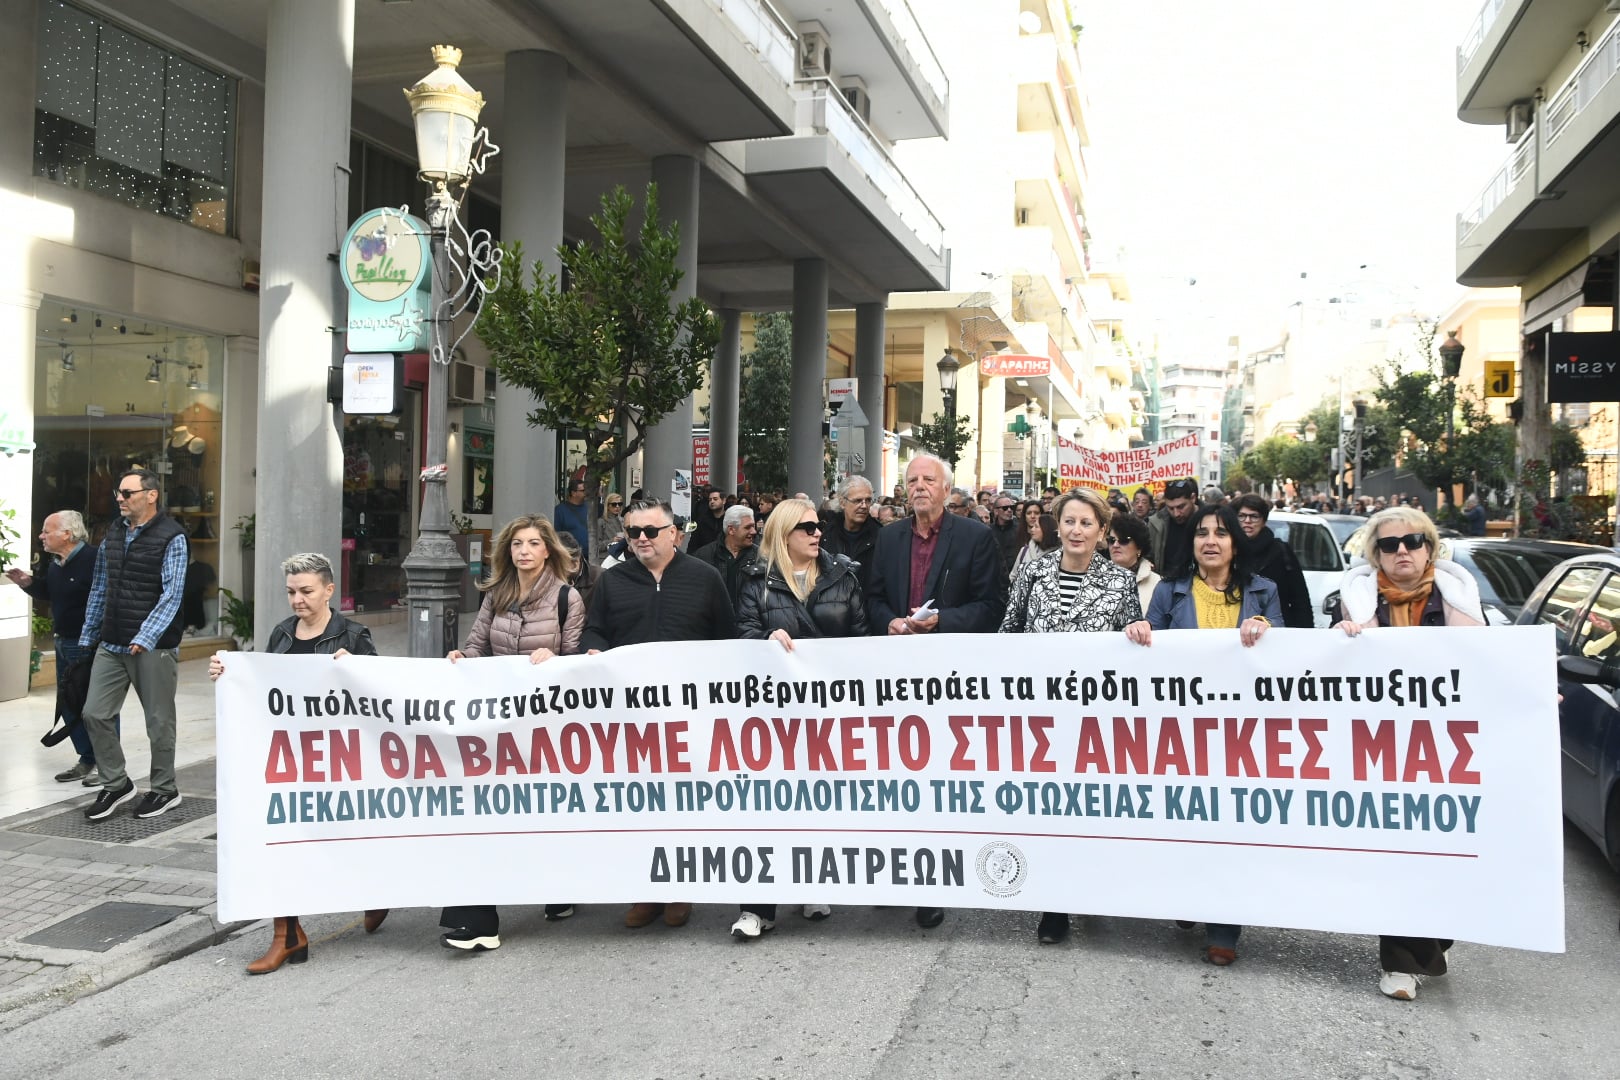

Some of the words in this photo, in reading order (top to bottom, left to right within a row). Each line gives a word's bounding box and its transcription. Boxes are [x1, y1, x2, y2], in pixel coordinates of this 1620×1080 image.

[999, 360, 1049, 370] ΑΡΑΠΗΣ
[695, 454, 709, 466] πά
[1060, 463, 1106, 483] ΕΝΑΝΤΙΑ
[1109, 474, 1136, 487] ΣΤΗΝ
[1138, 462, 1193, 482] ΕΞΑΘΛΙΩΣΗ
[1117, 459, 1154, 474] ΜΕΤΩΠΟ
[268, 687, 295, 717] Οι
[303, 688, 394, 723] πόλεις
[404, 698, 456, 726] μας
[466, 682, 614, 720] στενάζουν
[625, 684, 671, 709] και
[682, 682, 698, 710] η
[708, 674, 865, 708] κυβέρνηση
[875, 670, 990, 706] μετράει
[1001, 676, 1035, 700] τα
[1046, 670, 1138, 707] κέρδη
[1150, 676, 1241, 707] της...
[1254, 669, 1461, 708] ανάπτυξης!
[265, 728, 362, 784] ΔΕΝ
[379, 731, 447, 780] ΘΑ
[456, 721, 692, 777] ΒΑΛΟΥΜΕ
[707, 714, 931, 773] ΛΟΥΚΕΤΟ
[948, 715, 1057, 773] ΣΤΙΣ
[1074, 716, 1330, 780] ΑΝΑΓΚΕΣ
[1351, 719, 1481, 785] ΜΑΣ
[266, 785, 465, 824] ΔΙΕΚΔΙΚΟΥΜΕ
[473, 782, 586, 815] ΚΟΝΤΡΑ
[593, 781, 666, 813] ΣΤΟΝ
[675, 773, 921, 812] ΠΡΟΫΠΟΛΟΓΙΣΜΟ
[930, 779, 986, 814] ΤΗΣ
[995, 780, 1154, 819] ΦΤΩΧΕΙΑΣ
[1165, 785, 1219, 822] ΚΑΙ
[1230, 787, 1294, 825] ΤΟΥ
[1306, 789, 1482, 834] ΠΟΛΕΜΟΥ
[650, 845, 775, 884] ΔΗΜΟΣ
[791, 846, 965, 887] ΠΑΤΡΕΩΝ
